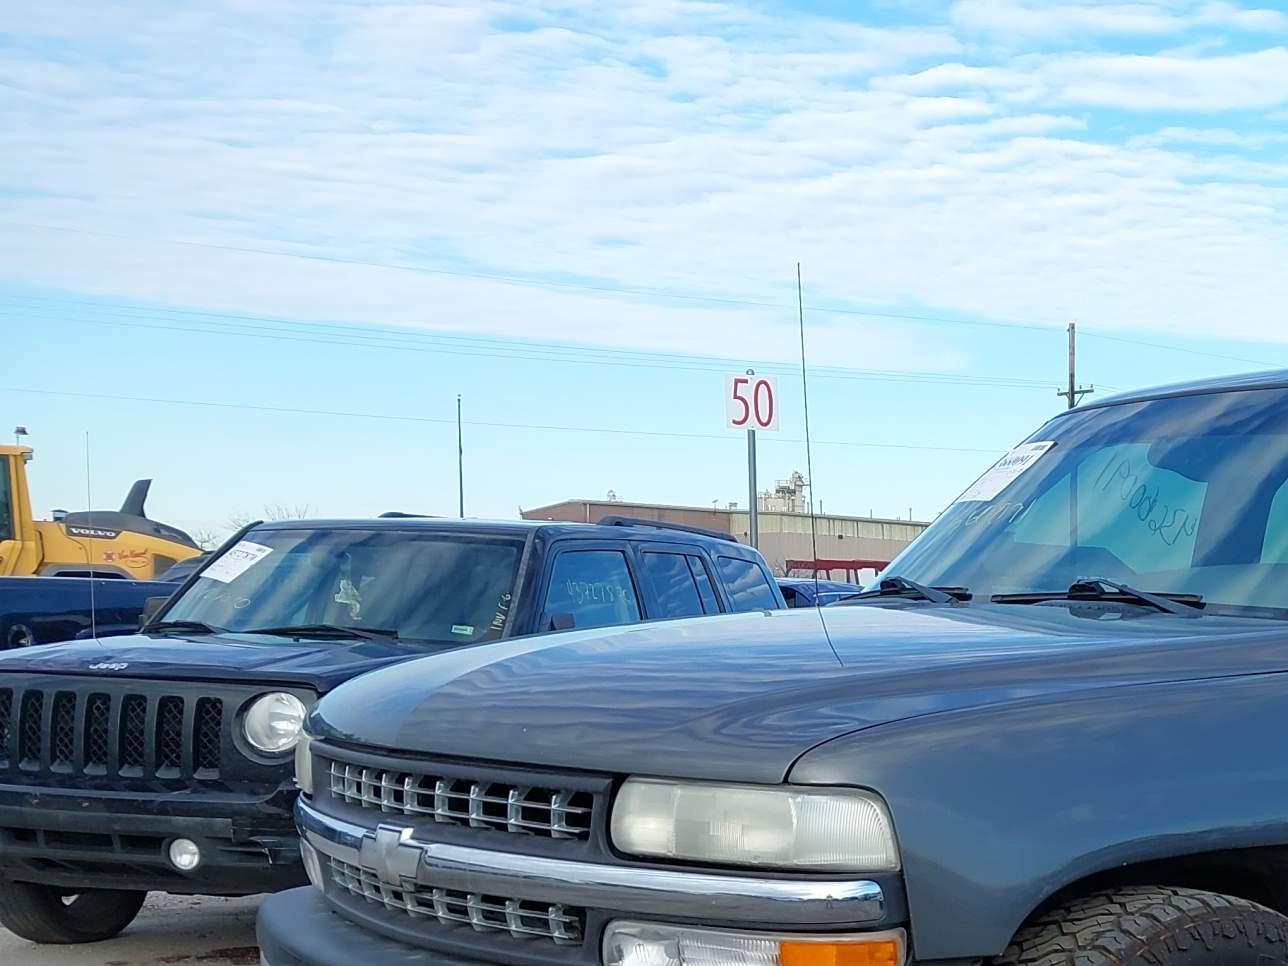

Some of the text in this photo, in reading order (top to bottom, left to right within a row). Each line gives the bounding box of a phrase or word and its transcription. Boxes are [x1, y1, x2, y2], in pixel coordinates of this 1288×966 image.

[732, 378, 773, 427] 50
[70, 527, 116, 537] VOLVO
[88, 662, 129, 671] Jeep
